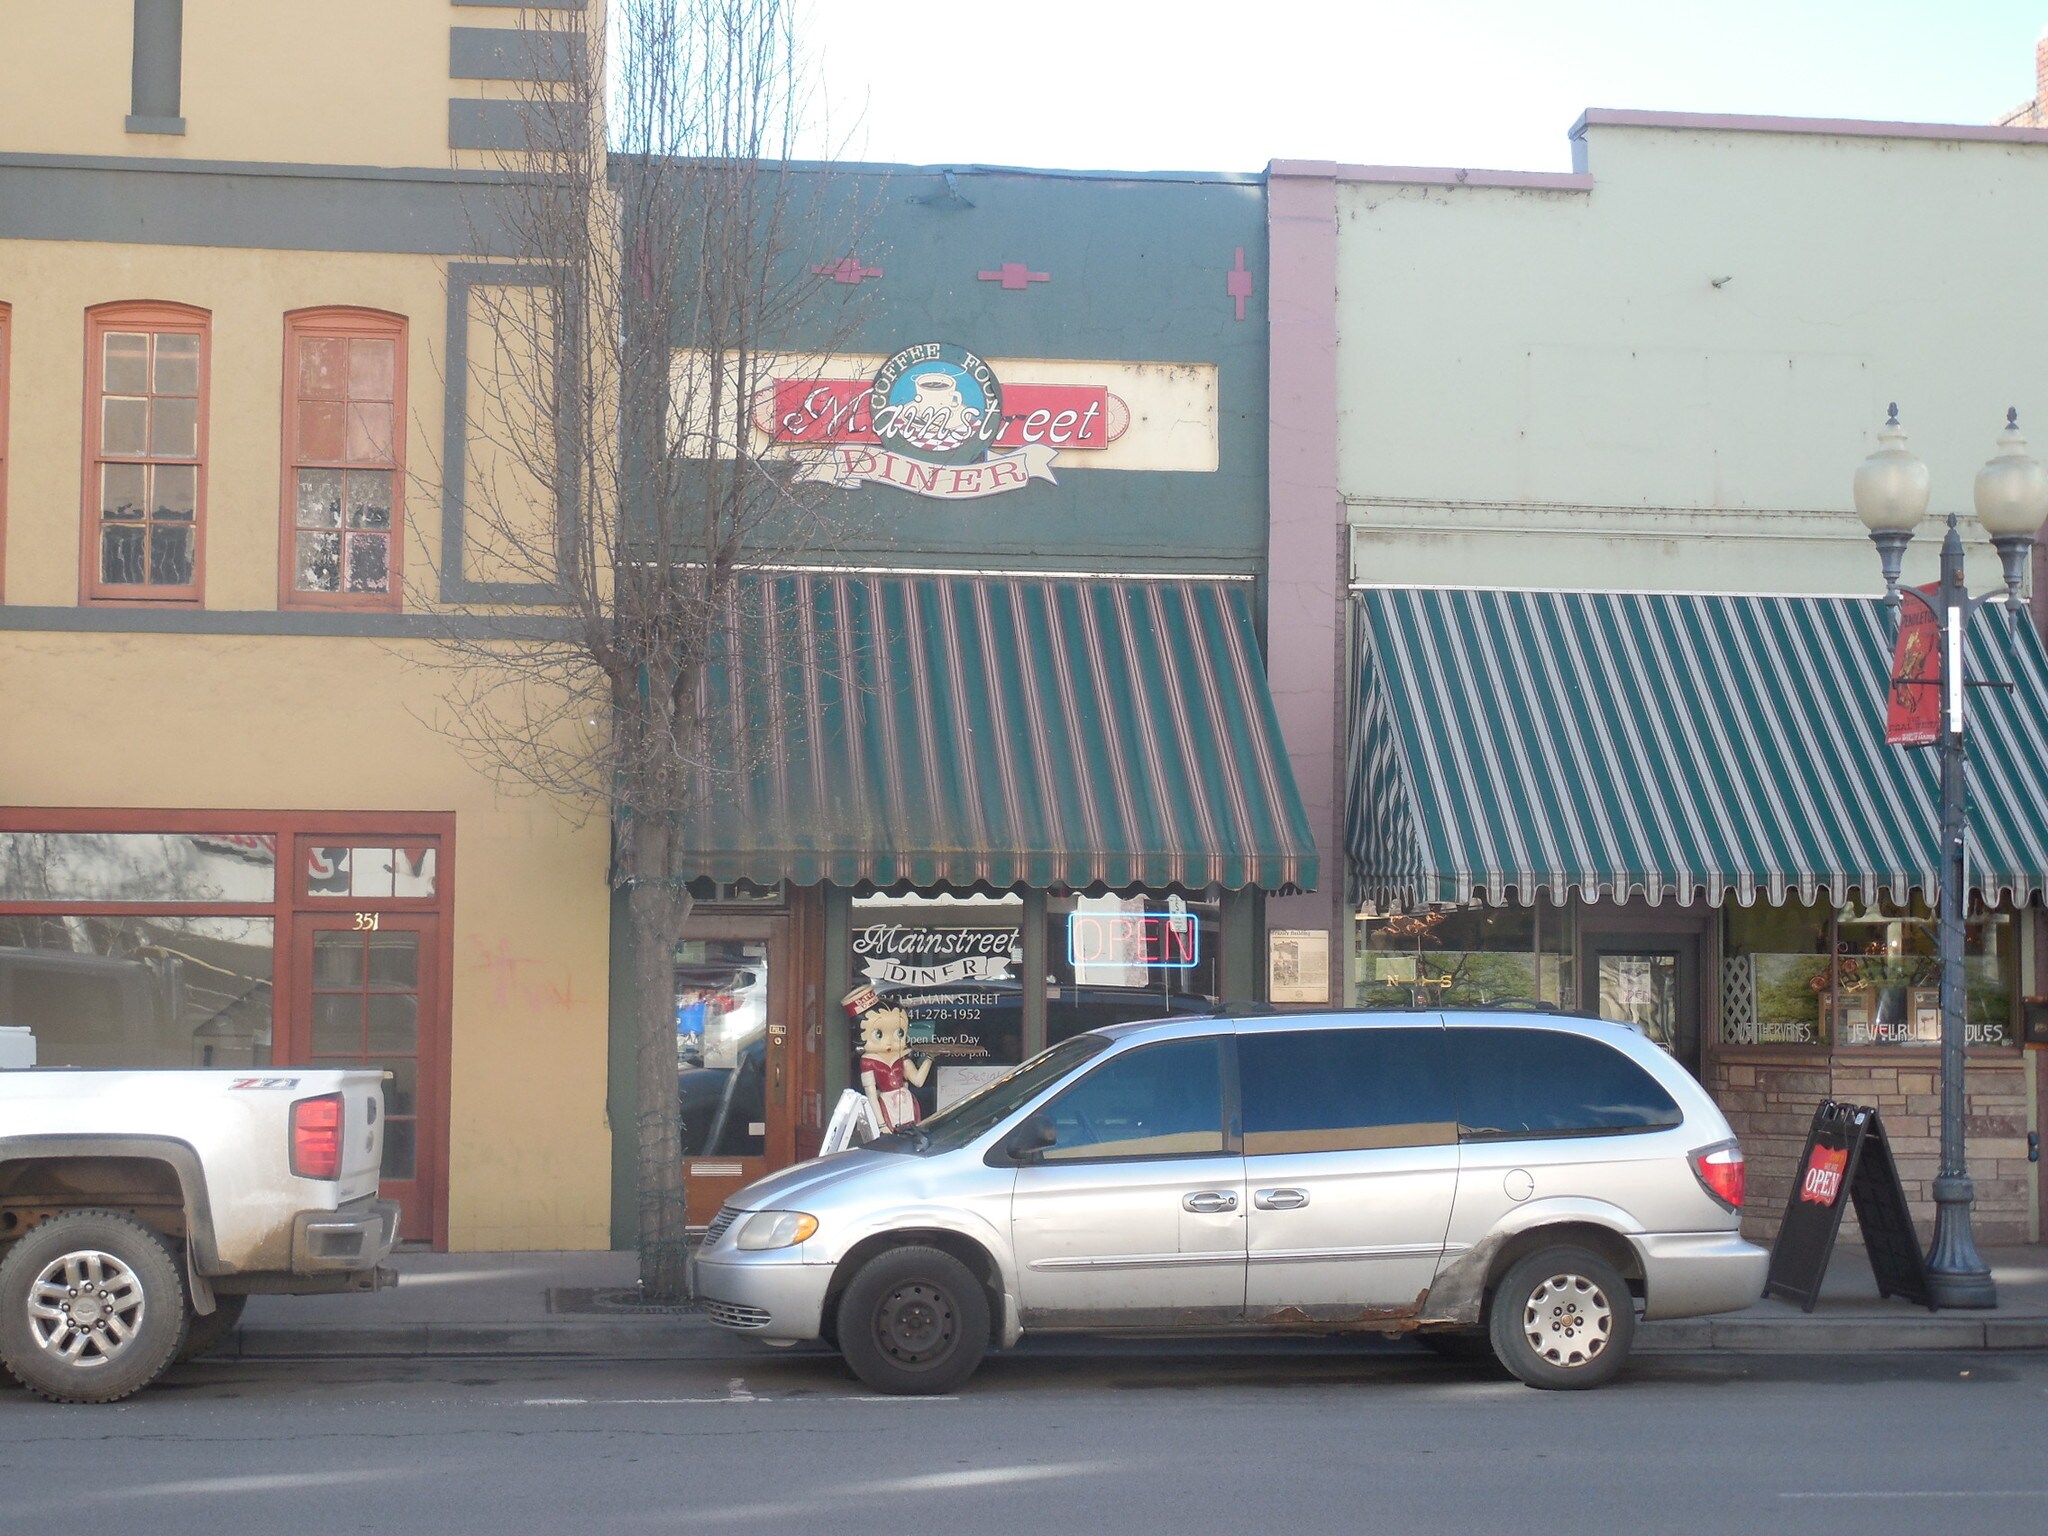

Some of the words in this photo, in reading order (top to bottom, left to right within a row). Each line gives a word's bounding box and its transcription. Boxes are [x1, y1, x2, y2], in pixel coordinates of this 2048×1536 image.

[871, 342, 941, 409] COFFEE
[782, 386, 1100, 443] Mainstreet
[836, 449, 1027, 494] DINER
[352, 912, 379, 931] 351
[852, 923, 1020, 954] Mainstreet
[1072, 918, 1193, 961] OPEN
[890, 959, 977, 984] DINER
[919, 993, 955, 1005] MAIN
[957, 993, 1000, 1005] STREET
[907, 1008, 981, 1020] 41-278-1952
[931, 1033, 958, 1045] Every
[960, 1033, 980, 1046] Day
[1849, 1023, 1917, 1043] JEWELRY
[228, 1078, 301, 1090] Z71
[1805, 1168, 1840, 1197] OPEN
